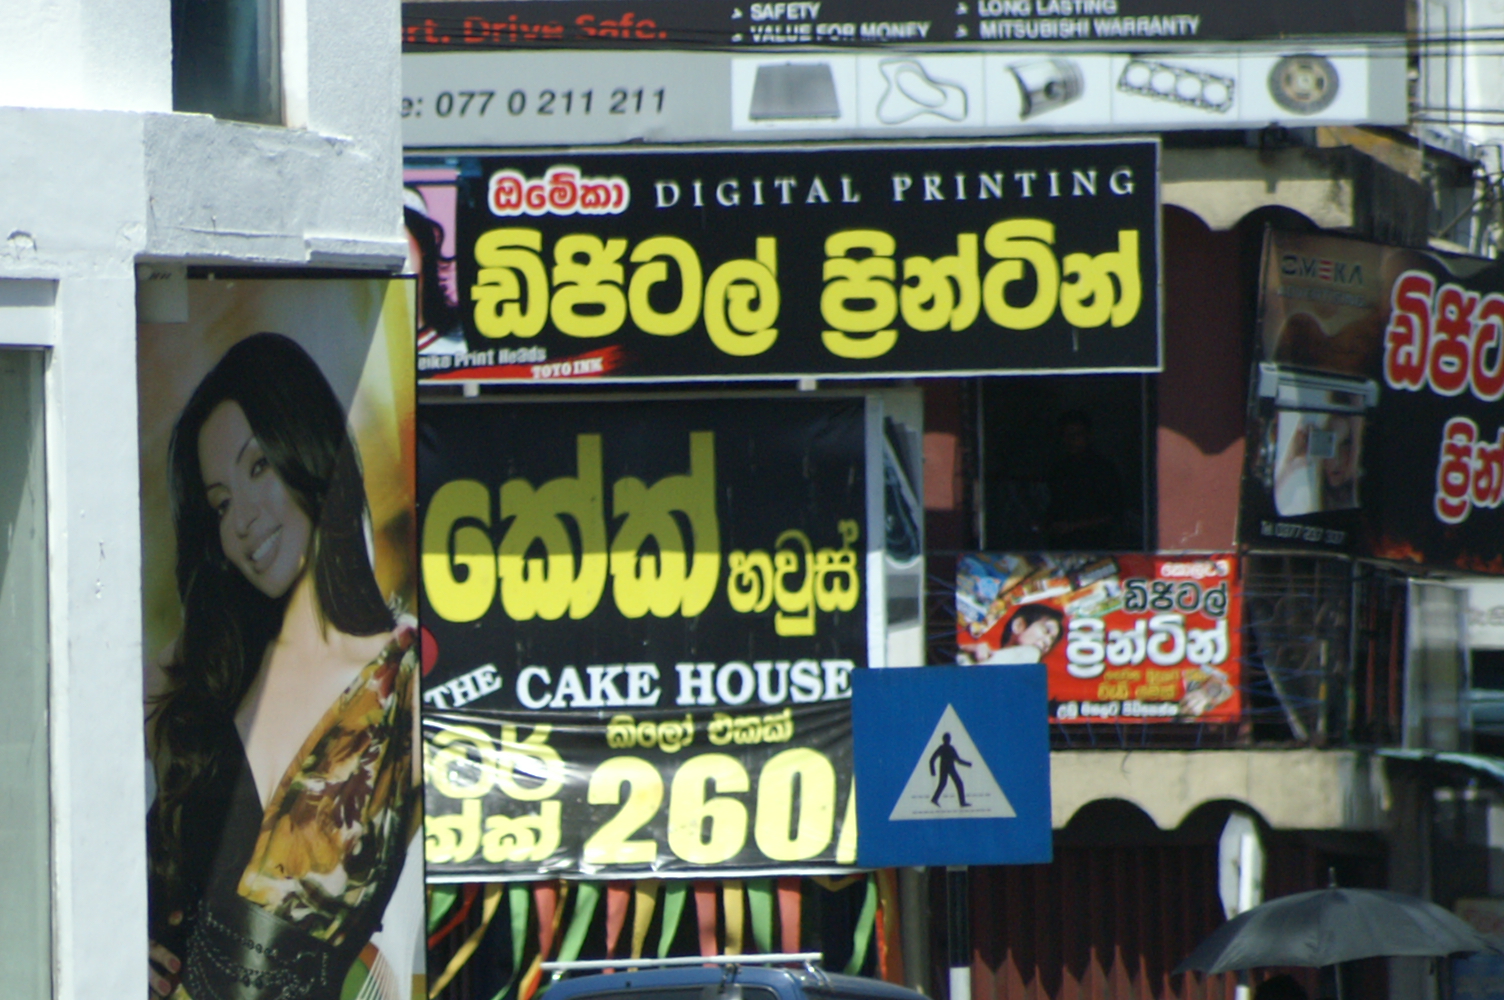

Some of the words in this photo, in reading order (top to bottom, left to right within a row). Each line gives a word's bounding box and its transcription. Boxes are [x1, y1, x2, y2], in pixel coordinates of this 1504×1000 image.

[750, 2, 821, 21] SAFETY
[977, 0, 1032, 17] LONG
[1035, 0, 1118, 16] LASTING
[402, 18, 451, 43] rt.
[463, 14, 565, 43] Drive
[750, 24, 812, 43] VALUE
[816, 23, 857, 42] FOR
[860, 21, 931, 41] MONEY
[979, 18, 1091, 39] MITSUBISHI
[1094, 14, 1201, 37] WARRANTY
[435, 90, 496, 118] 077
[507, 89, 527, 116] 0
[537, 88, 594, 116] 211
[609, 86, 666, 115] 211
[655, 176, 861, 208] DIGITAL
[892, 169, 1135, 202] PRINTING
[454, 349, 495, 368] Print
[424, 664, 503, 710] THE
[515, 663, 662, 709] CAKE
[675, 659, 854, 705] HOUSE
